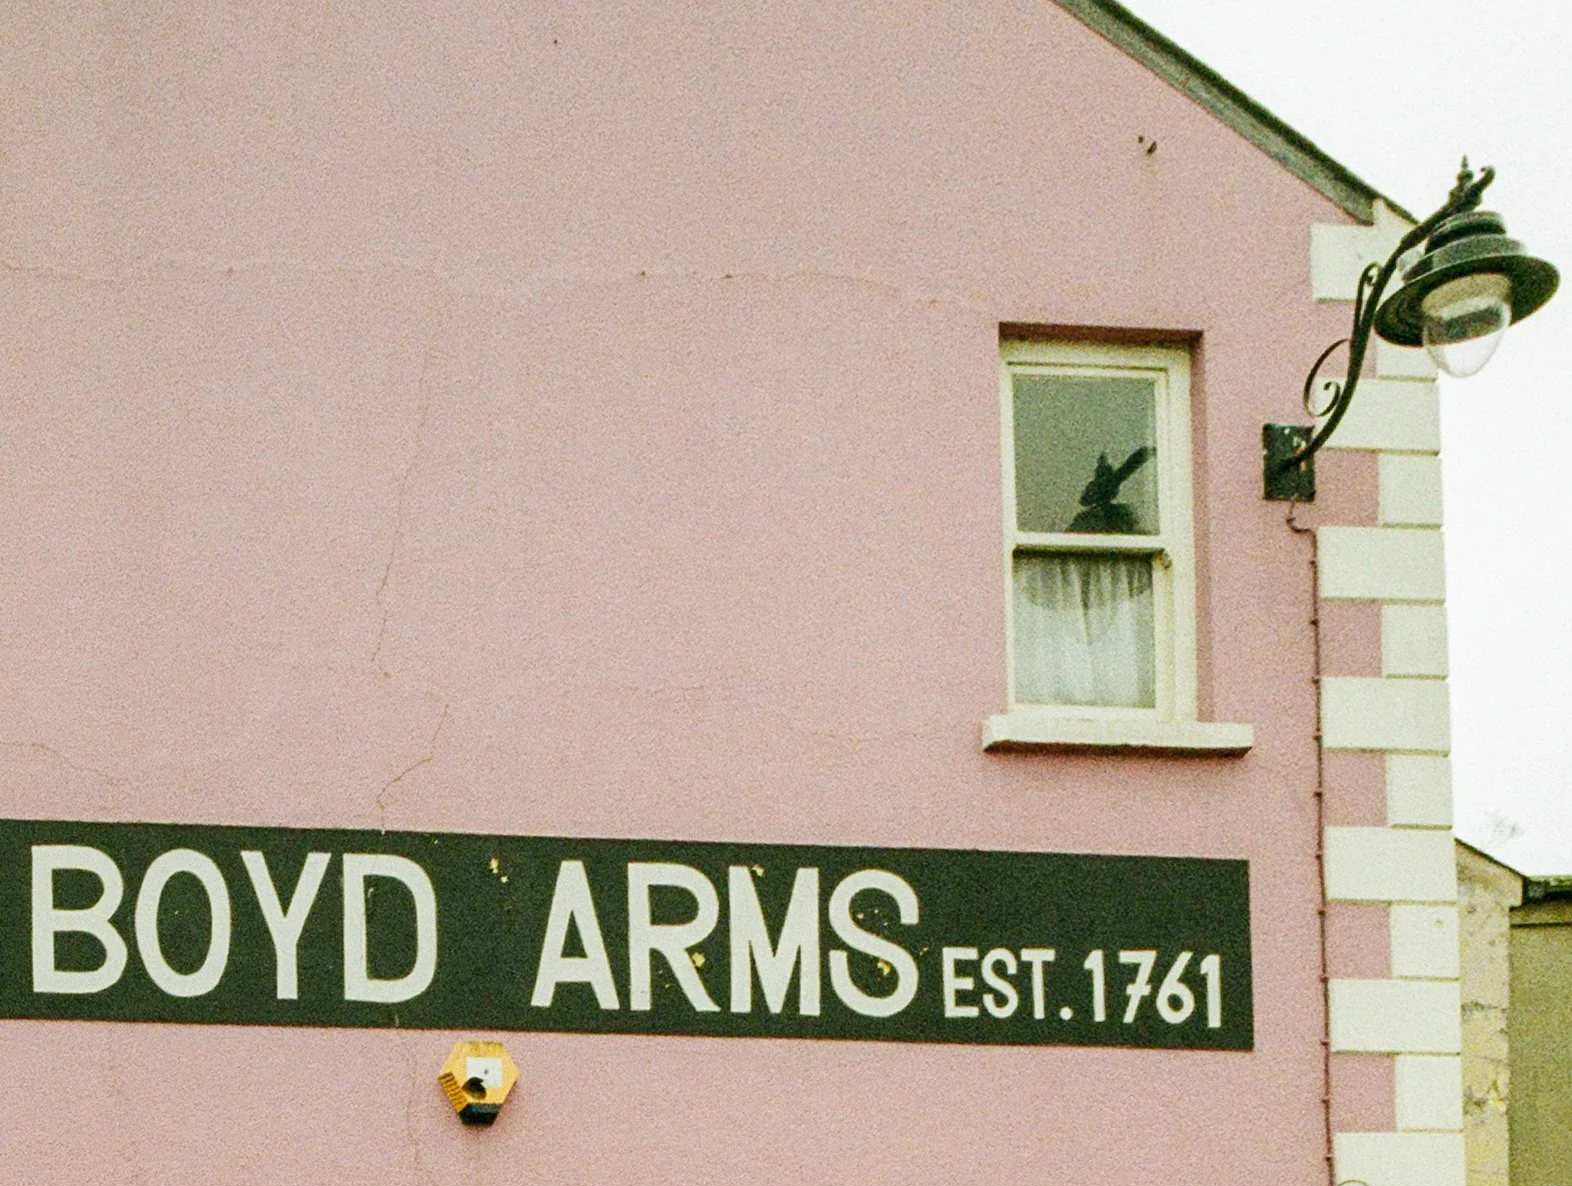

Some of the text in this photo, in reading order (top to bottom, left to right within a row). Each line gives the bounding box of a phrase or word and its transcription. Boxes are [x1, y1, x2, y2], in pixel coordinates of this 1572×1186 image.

[30, 844, 438, 1004] BOYD
[530, 860, 920, 1019] ARMS
[1083, 949, 1222, 1029] 1761
